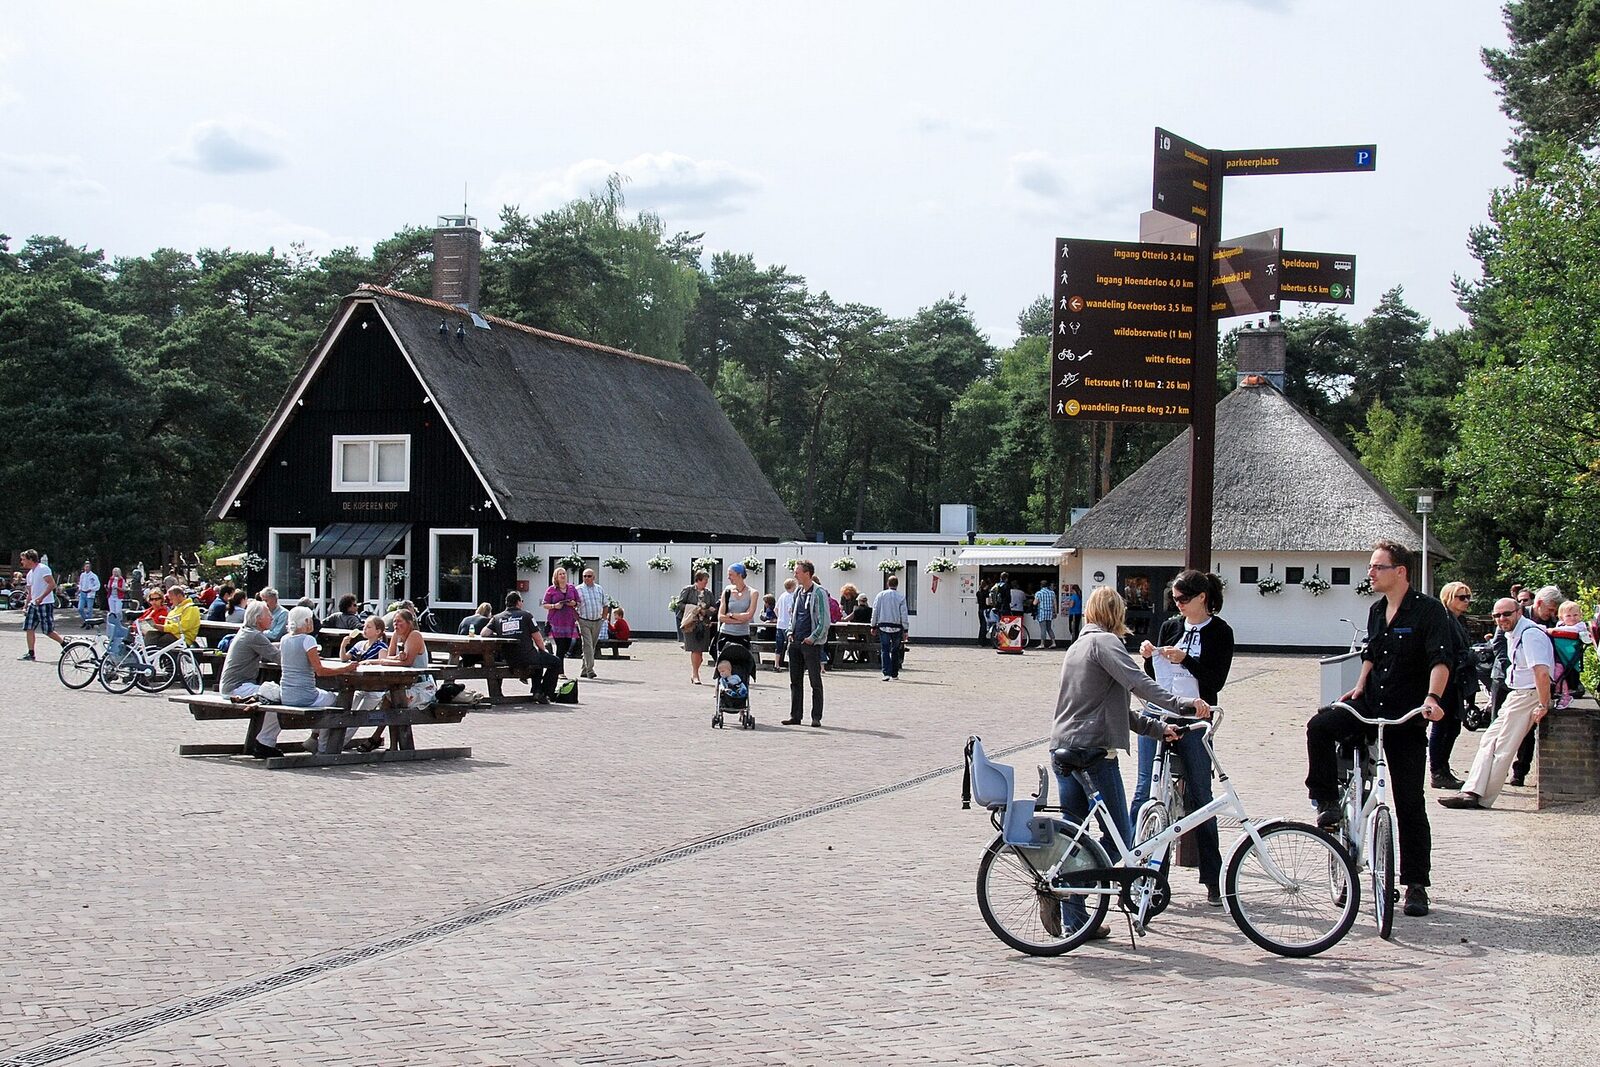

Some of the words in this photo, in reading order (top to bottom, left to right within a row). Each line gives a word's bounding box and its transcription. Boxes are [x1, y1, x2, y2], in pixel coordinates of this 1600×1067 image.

[1226, 157, 1279, 168] parkeerplaats
[1358, 152, 1369, 164] P
[1114, 248, 1140, 260] ingang
[1142, 251, 1168, 260] Otterlo
[1170, 253, 1181, 262] 3,4
[1183, 254, 1194, 262] km
[1096, 274, 1122, 286] ingang
[1125, 276, 1167, 286] Hoenderloo
[1169, 279, 1181, 287] 4,0
[1182, 280, 1193, 288] km
[1086, 300, 1125, 311] wandeling
[1128, 301, 1166, 311] Koeverbos
[1168, 303, 1179, 312] 3,5
[1182, 304, 1192, 312] km
[1114, 327, 1168, 338] wildobservatie
[1169, 330, 1176, 339] (1
[1178, 330, 1191, 339] km)
[1145, 355, 1164, 364] witte
[1166, 356, 1190, 364] fietsen
[1084, 377, 1120, 387] fietsroute
[1122, 380, 1132, 388] (1:
[1134, 380, 1143, 388] 10
[1145, 380, 1155, 388] km
[1157, 381, 1164, 389] 2:
[1166, 381, 1175, 389] 26
[1177, 381, 1190, 390] km)
[1081, 403, 1119, 413] wandeling
[1121, 405, 1145, 413] Franse
[1147, 405, 1164, 415] Berg
[1166, 406, 1176, 414] 2,7
[1178, 406, 1189, 414] km
[343, 502, 351, 510] DE
